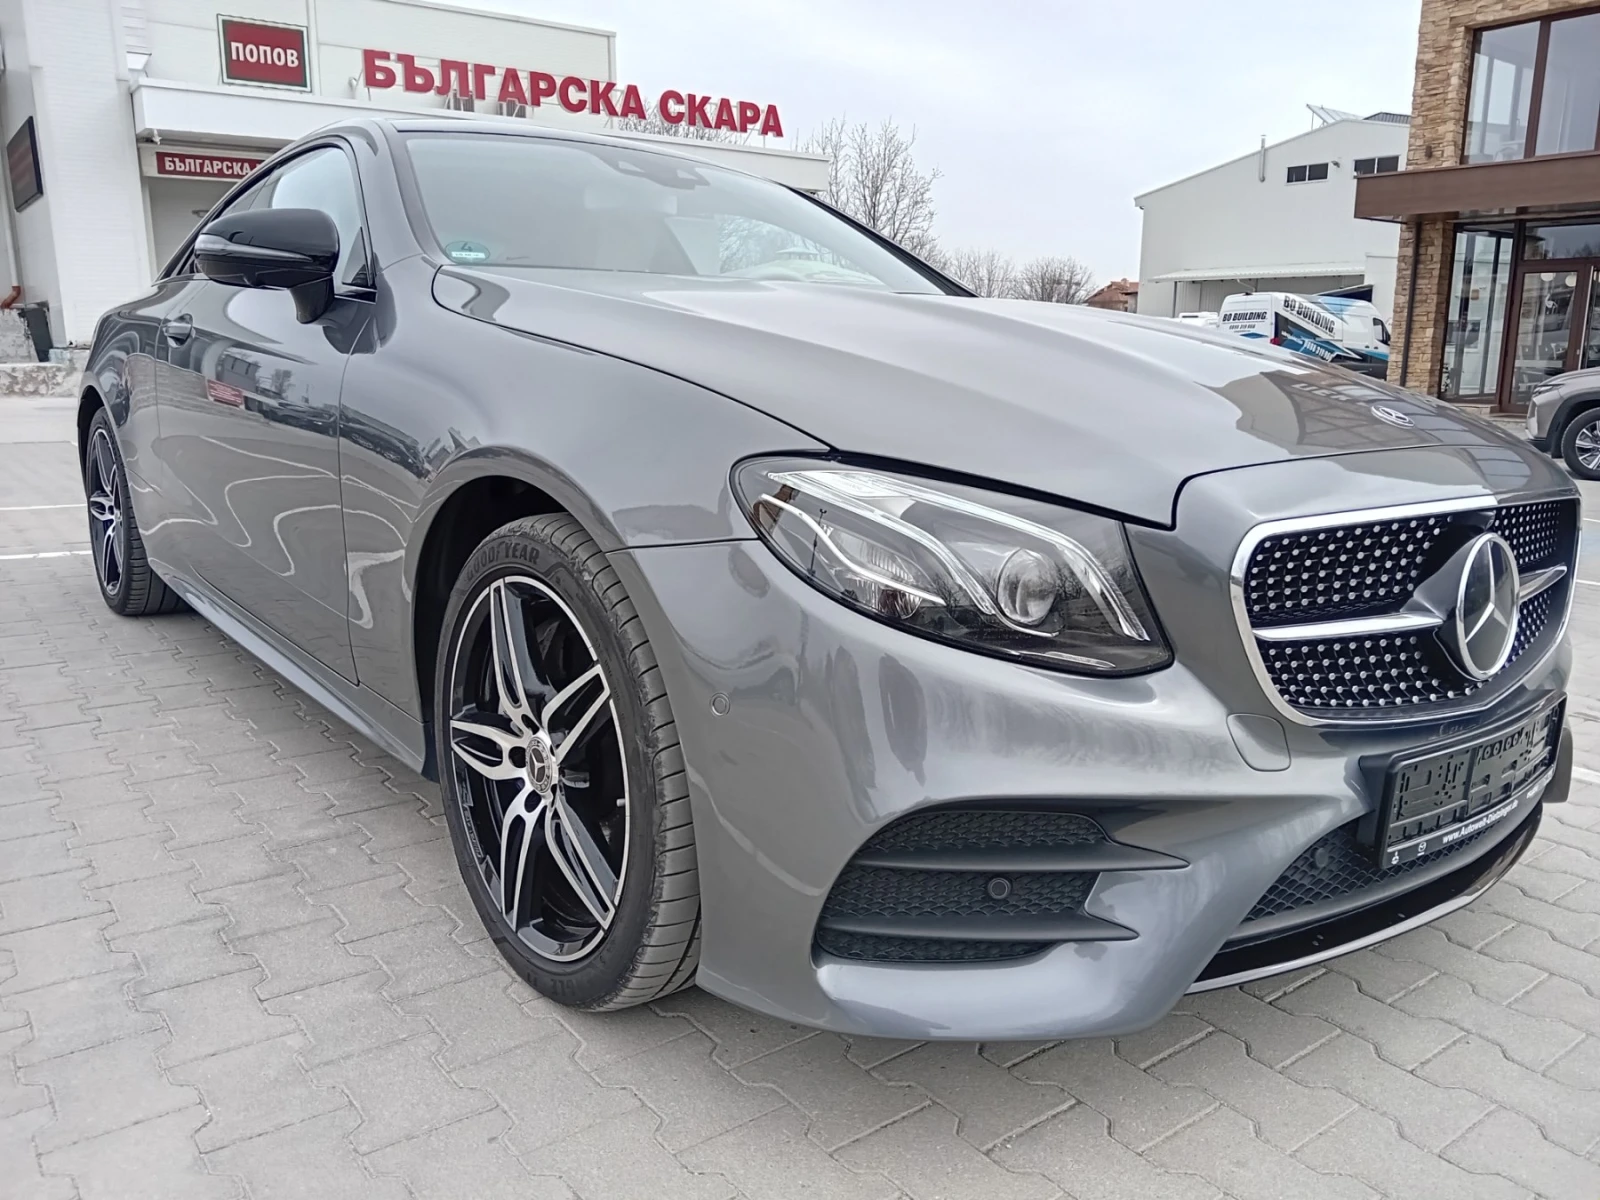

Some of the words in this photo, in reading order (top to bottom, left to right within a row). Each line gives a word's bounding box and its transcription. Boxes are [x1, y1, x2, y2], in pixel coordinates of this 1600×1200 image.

[230, 41, 300, 68] ПОПОВ
[362, 48, 647, 120] БЪЛГАРСКА
[658, 89, 784, 138] СКАРА
[164, 156, 252, 176] БЪЛГАРСКА
[466, 540, 541, 582] GOODYEAR
